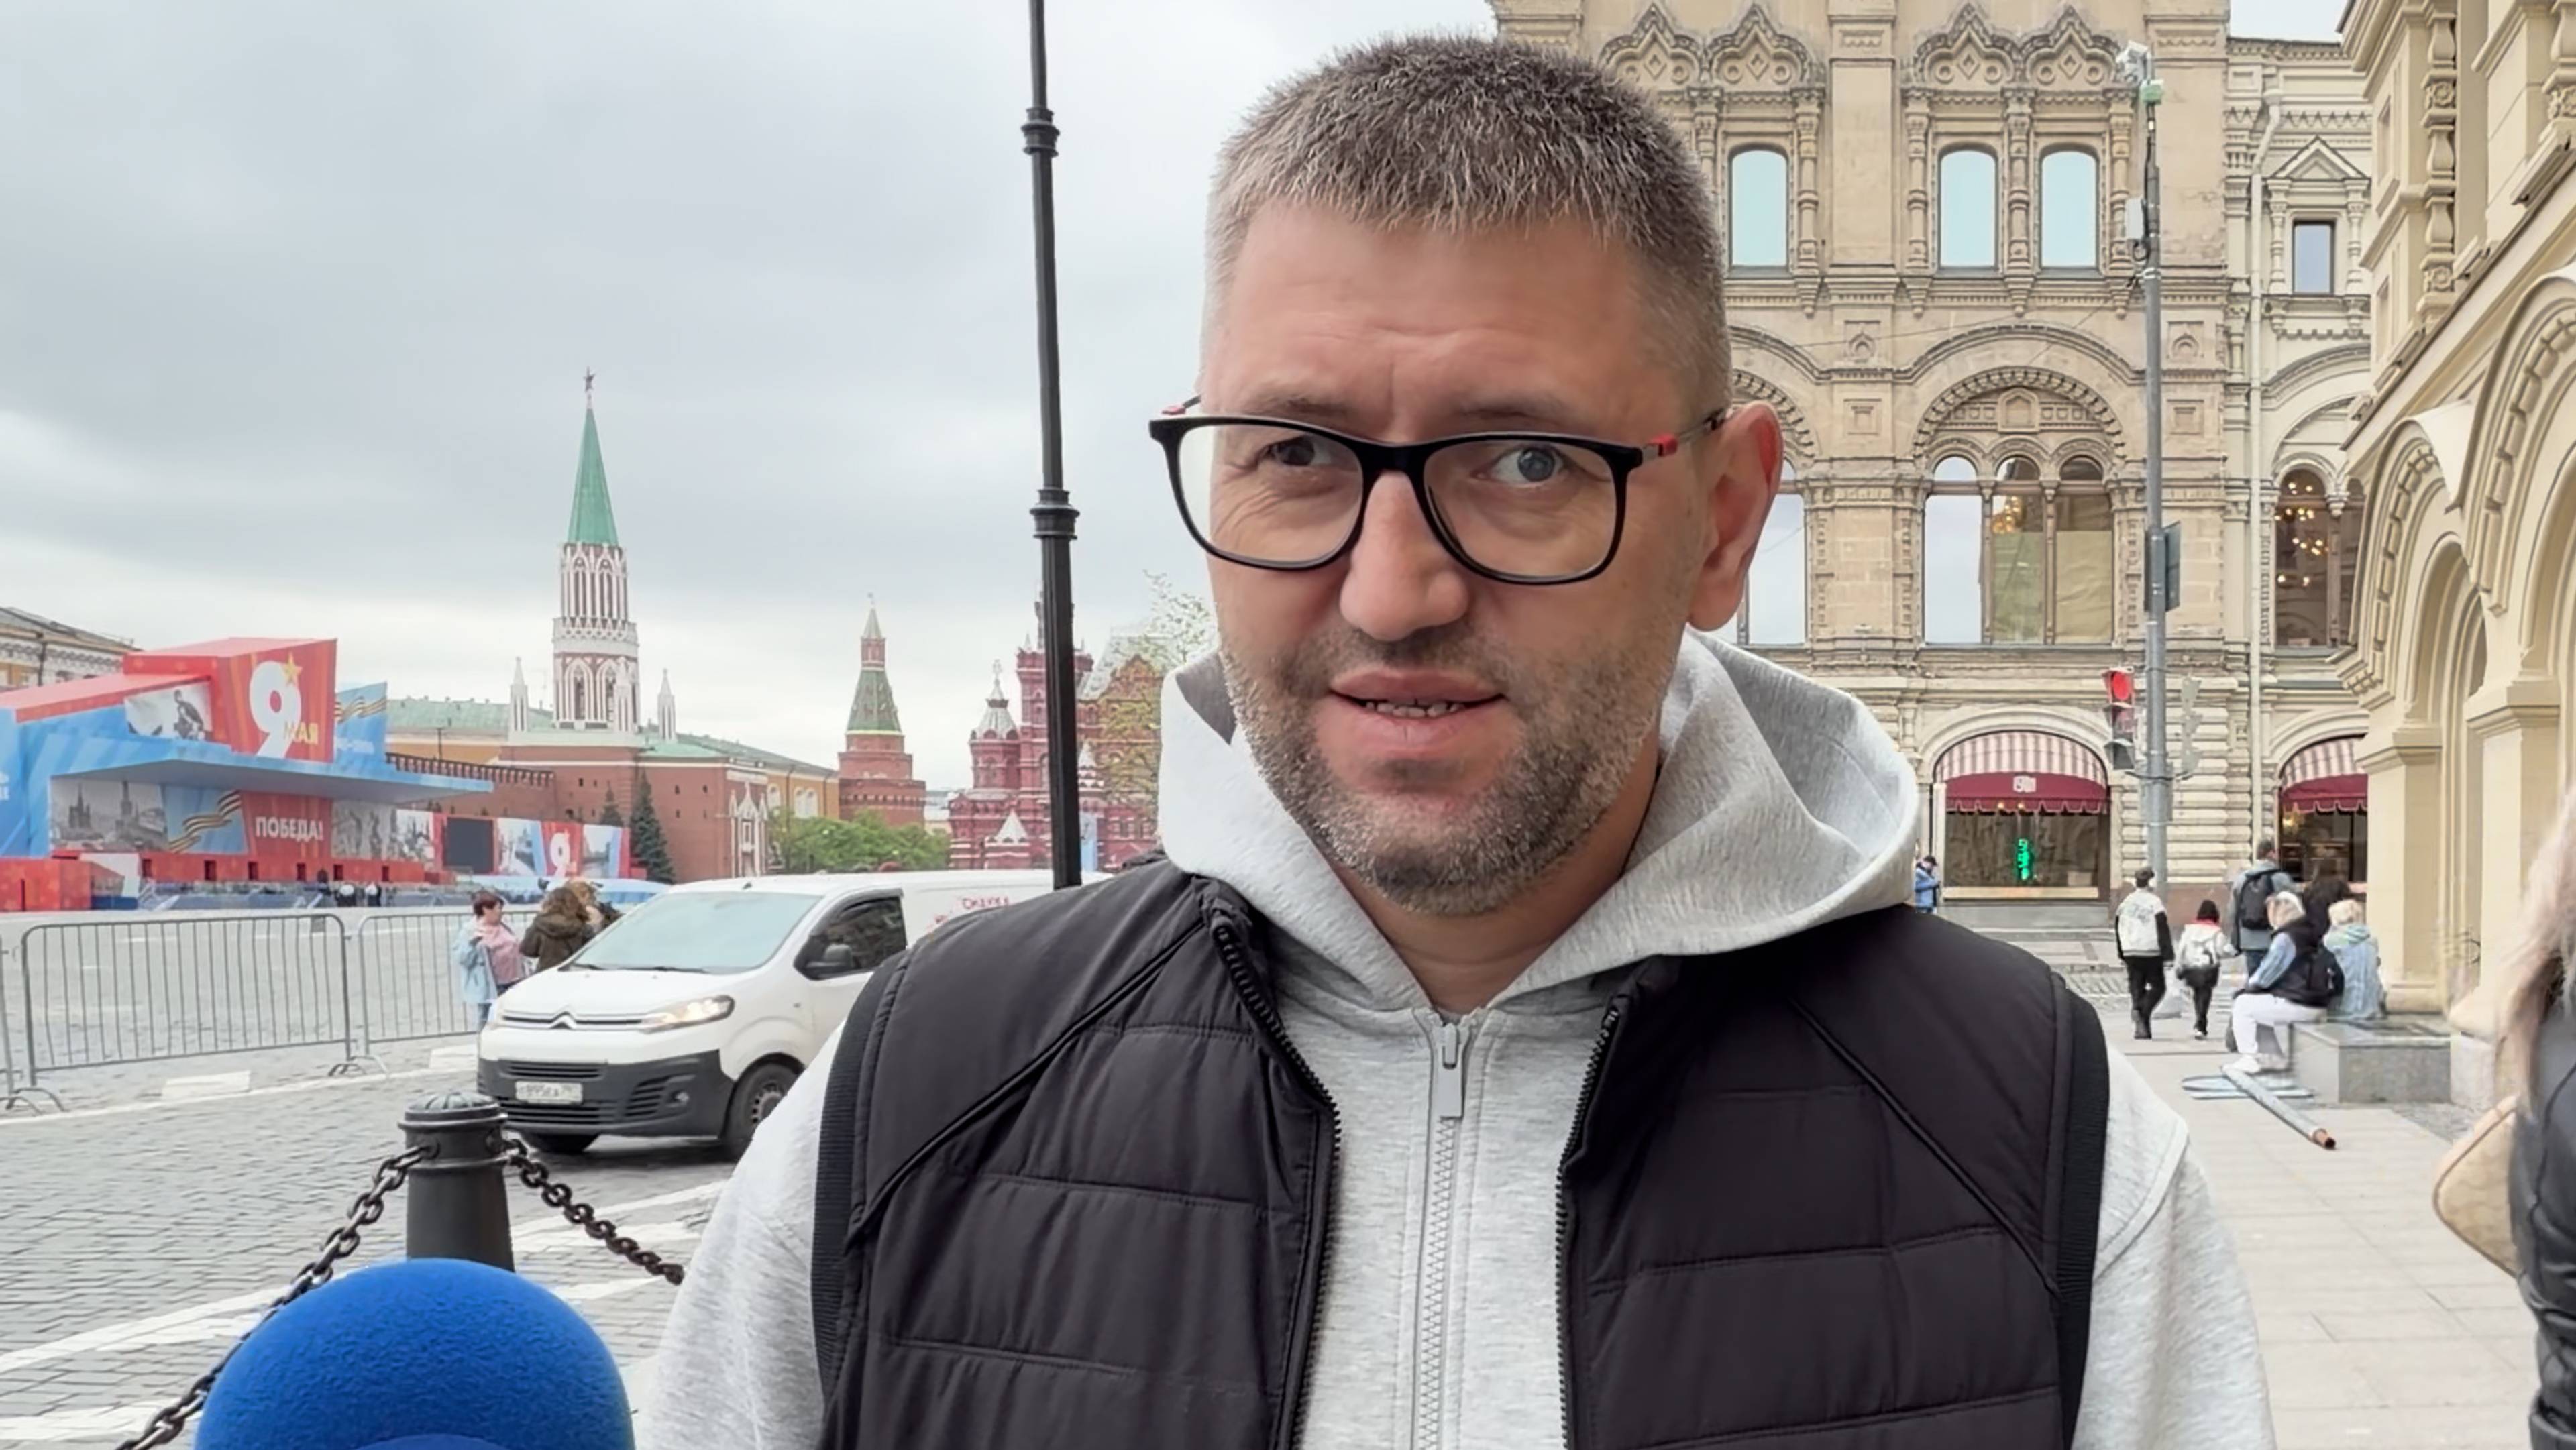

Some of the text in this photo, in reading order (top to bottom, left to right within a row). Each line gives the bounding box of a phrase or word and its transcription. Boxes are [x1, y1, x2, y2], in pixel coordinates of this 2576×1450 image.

[249, 660, 302, 758] 9
[284, 721, 319, 746] МАЯ
[256, 816, 324, 842] ПОБЕДА!
